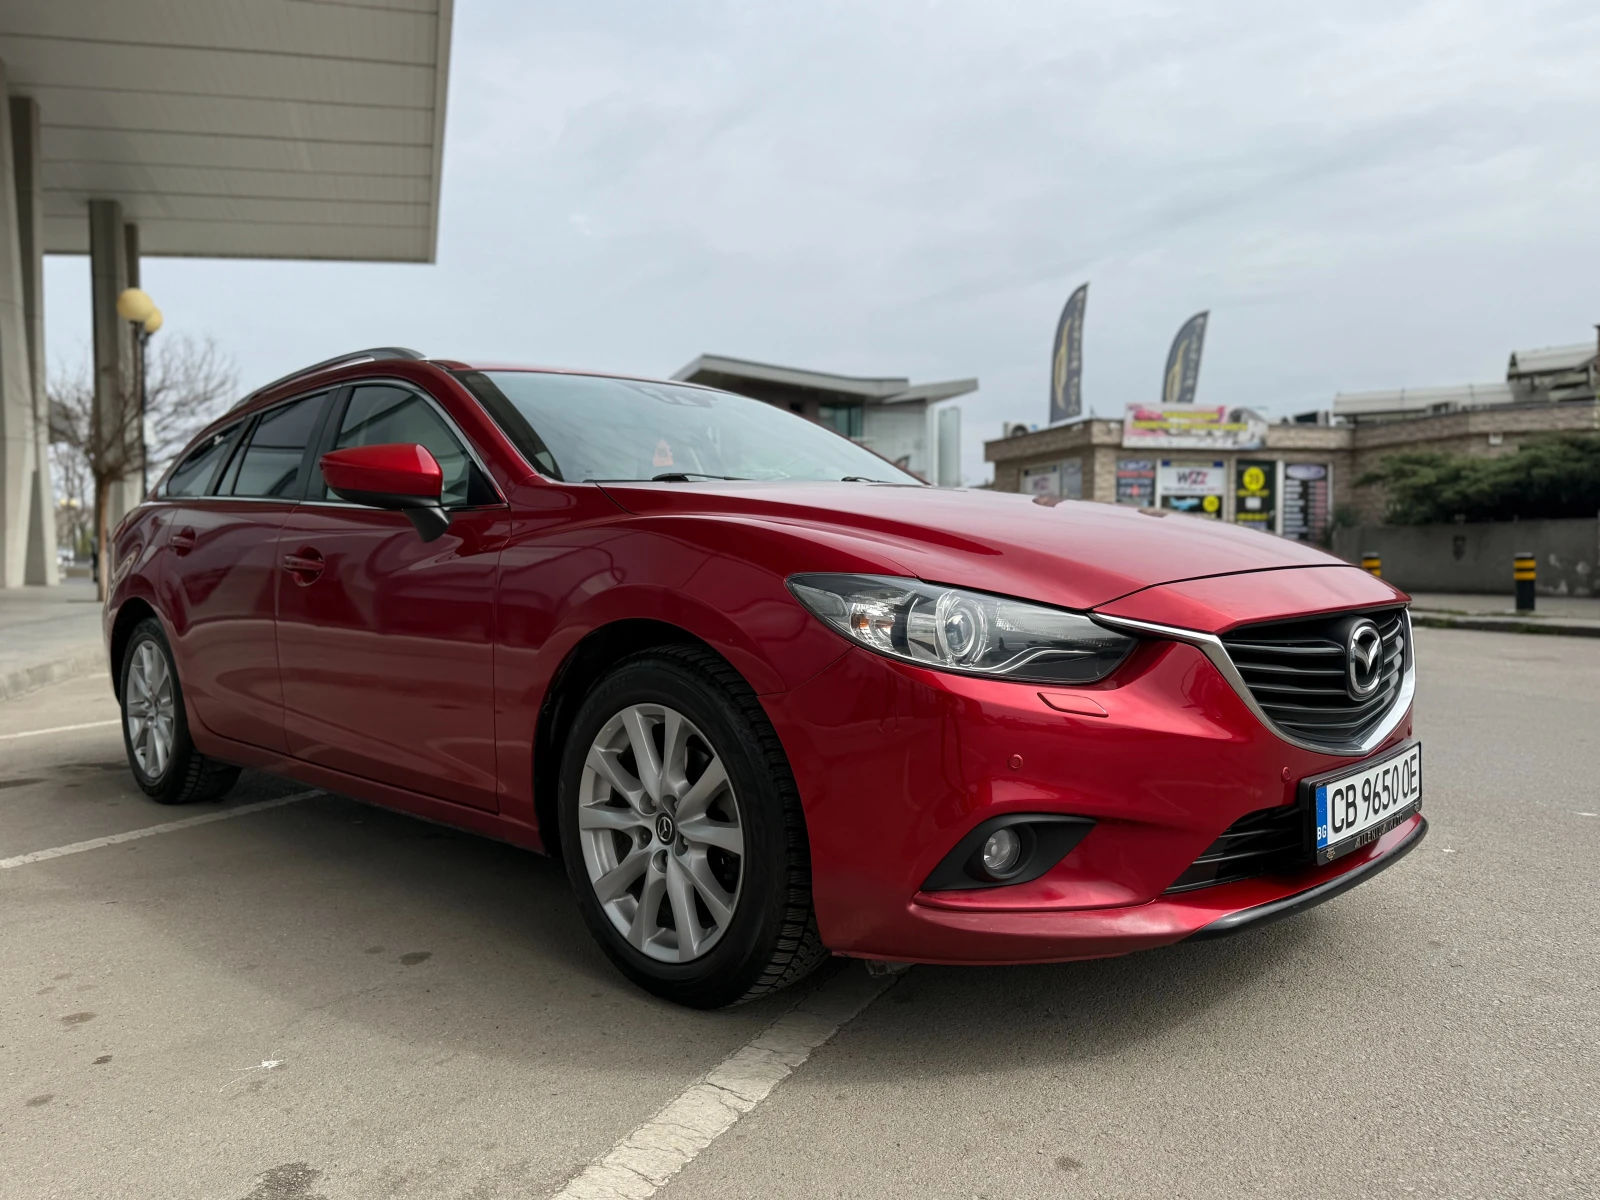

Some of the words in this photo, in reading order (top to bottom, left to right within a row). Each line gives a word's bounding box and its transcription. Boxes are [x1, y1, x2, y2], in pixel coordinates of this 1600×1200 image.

[1331, 783, 1357, 834] CB
[1361, 764, 1400, 821] 9650
[1317, 825, 1327, 840] BG
